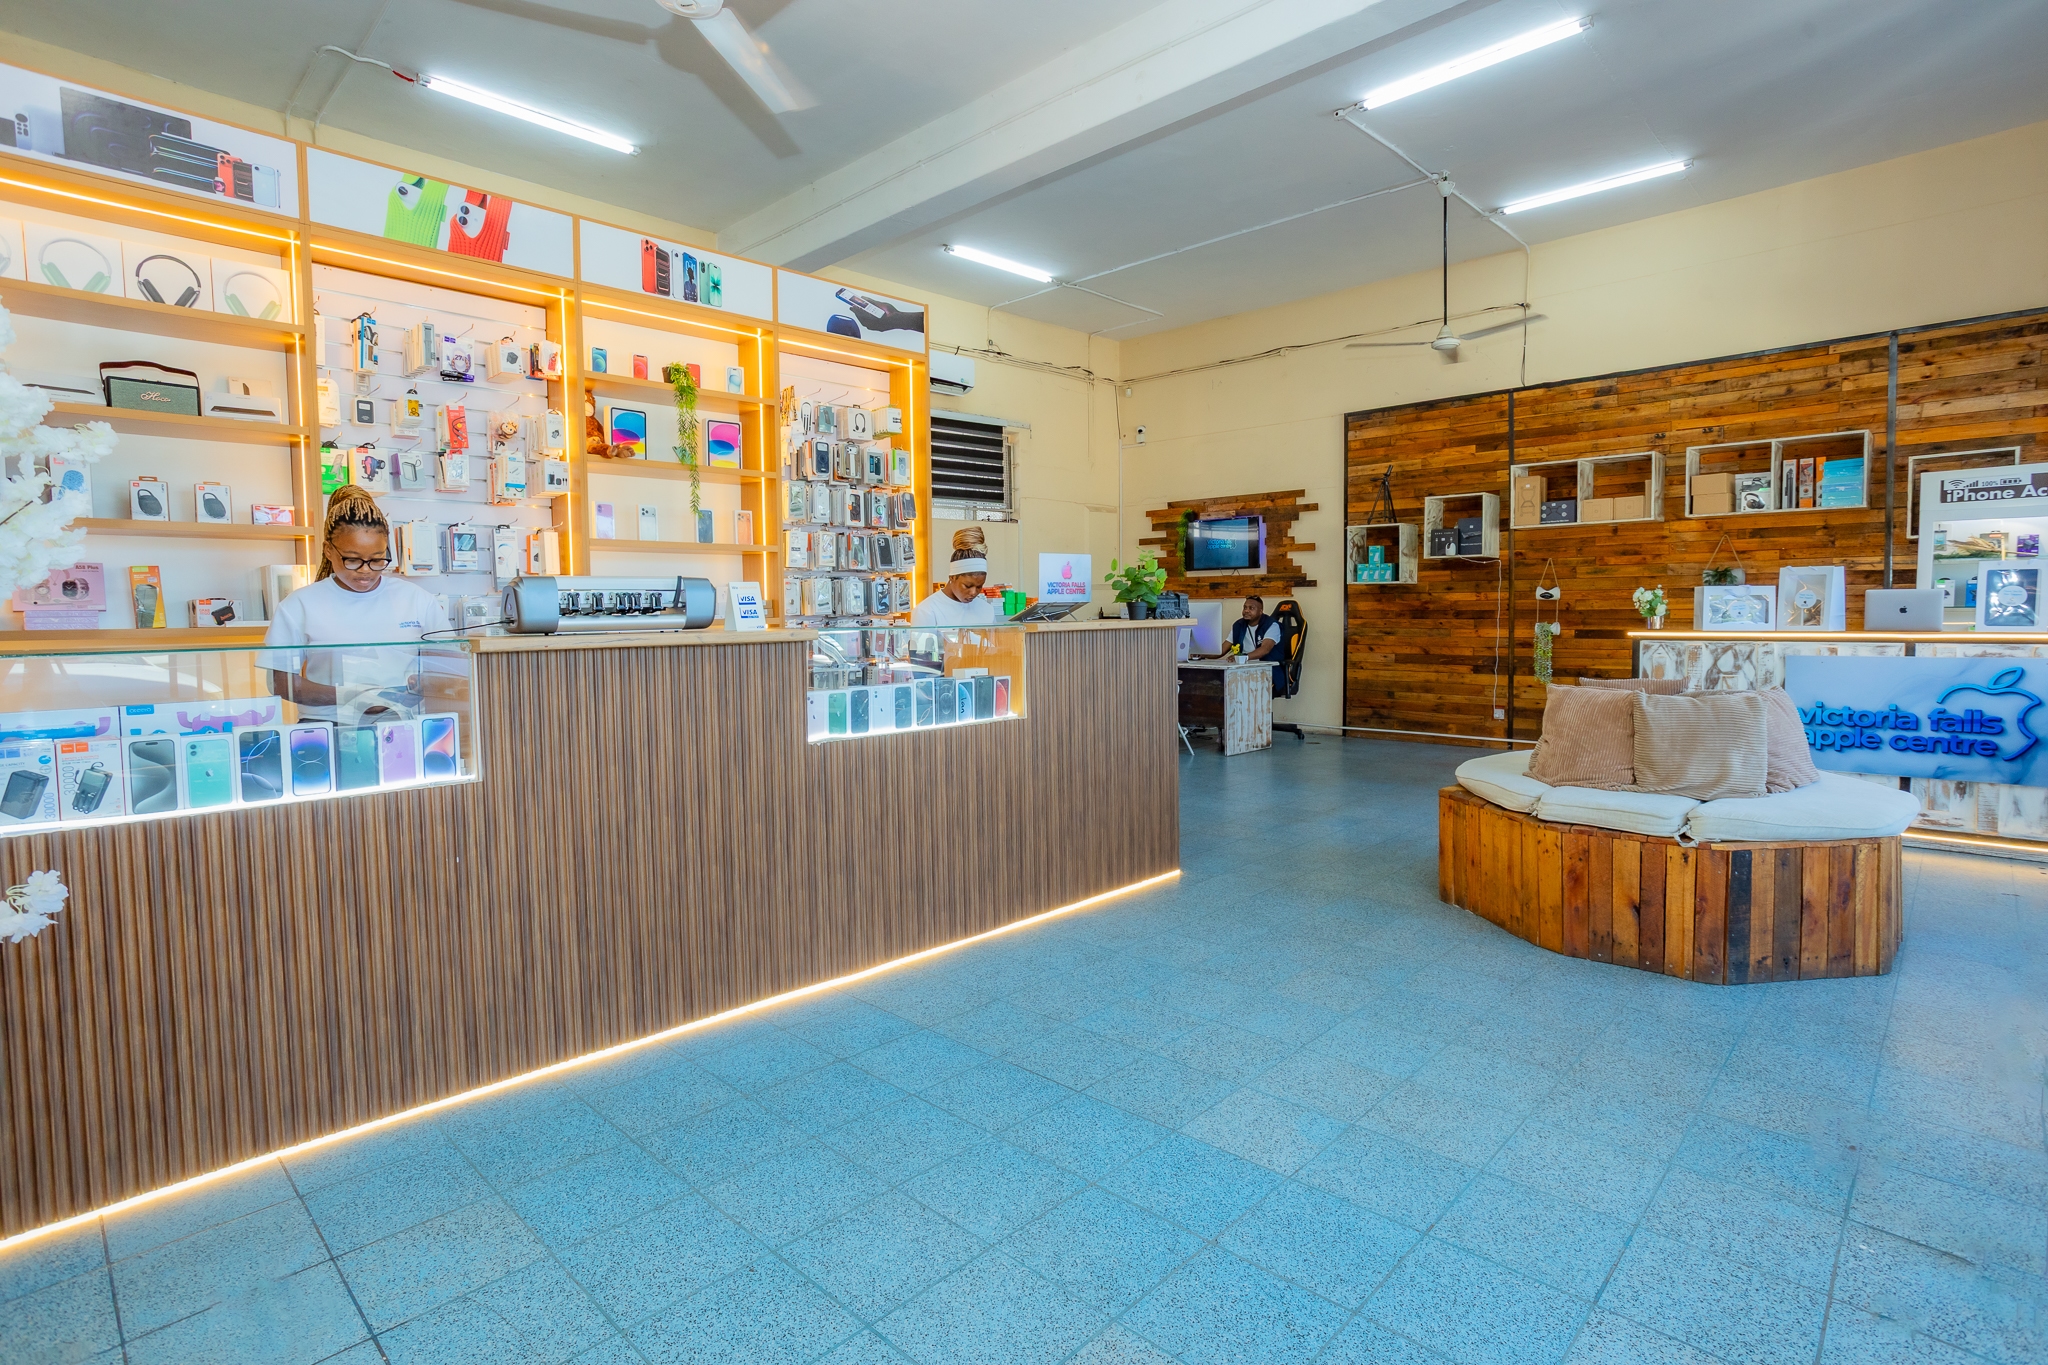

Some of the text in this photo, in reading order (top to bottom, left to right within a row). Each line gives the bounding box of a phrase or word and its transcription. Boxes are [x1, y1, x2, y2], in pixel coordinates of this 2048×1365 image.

[1946, 487, 2015, 503] iPhone
[1796, 701, 2004, 735] victoria falls
[1804, 727, 1999, 757] apple centre
